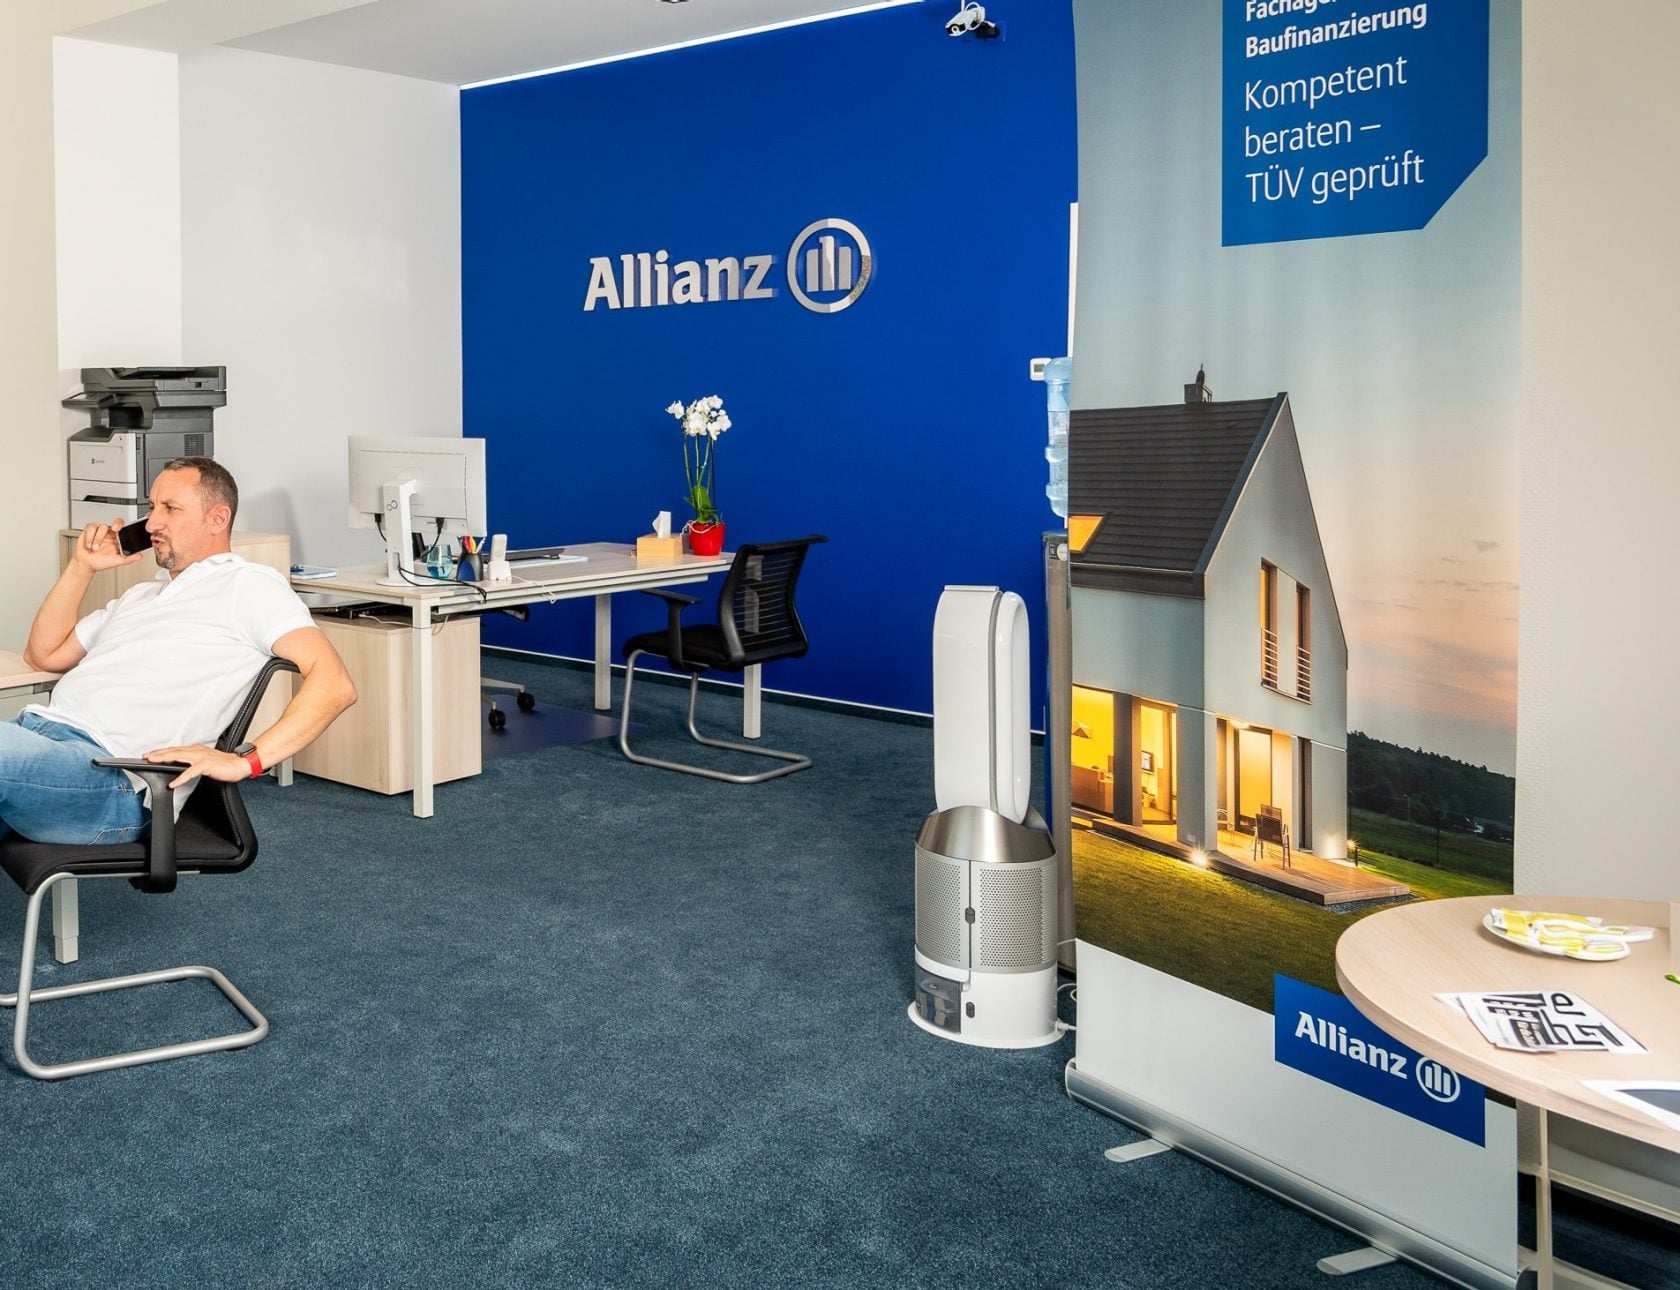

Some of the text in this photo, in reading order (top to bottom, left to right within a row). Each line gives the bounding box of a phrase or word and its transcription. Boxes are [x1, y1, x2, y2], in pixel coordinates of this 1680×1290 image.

[1245, 3, 1428, 58] Baufinanzierung
[1246, 0, 1337, 22] Fachag
[1245, 56, 1408, 112] Kompetent
[1245, 119, 1352, 158] beraten
[1245, 150, 1425, 205] TÜV geprüft
[583, 249, 776, 312] Allianz
[1295, 1011, 1408, 1080] Allianz
